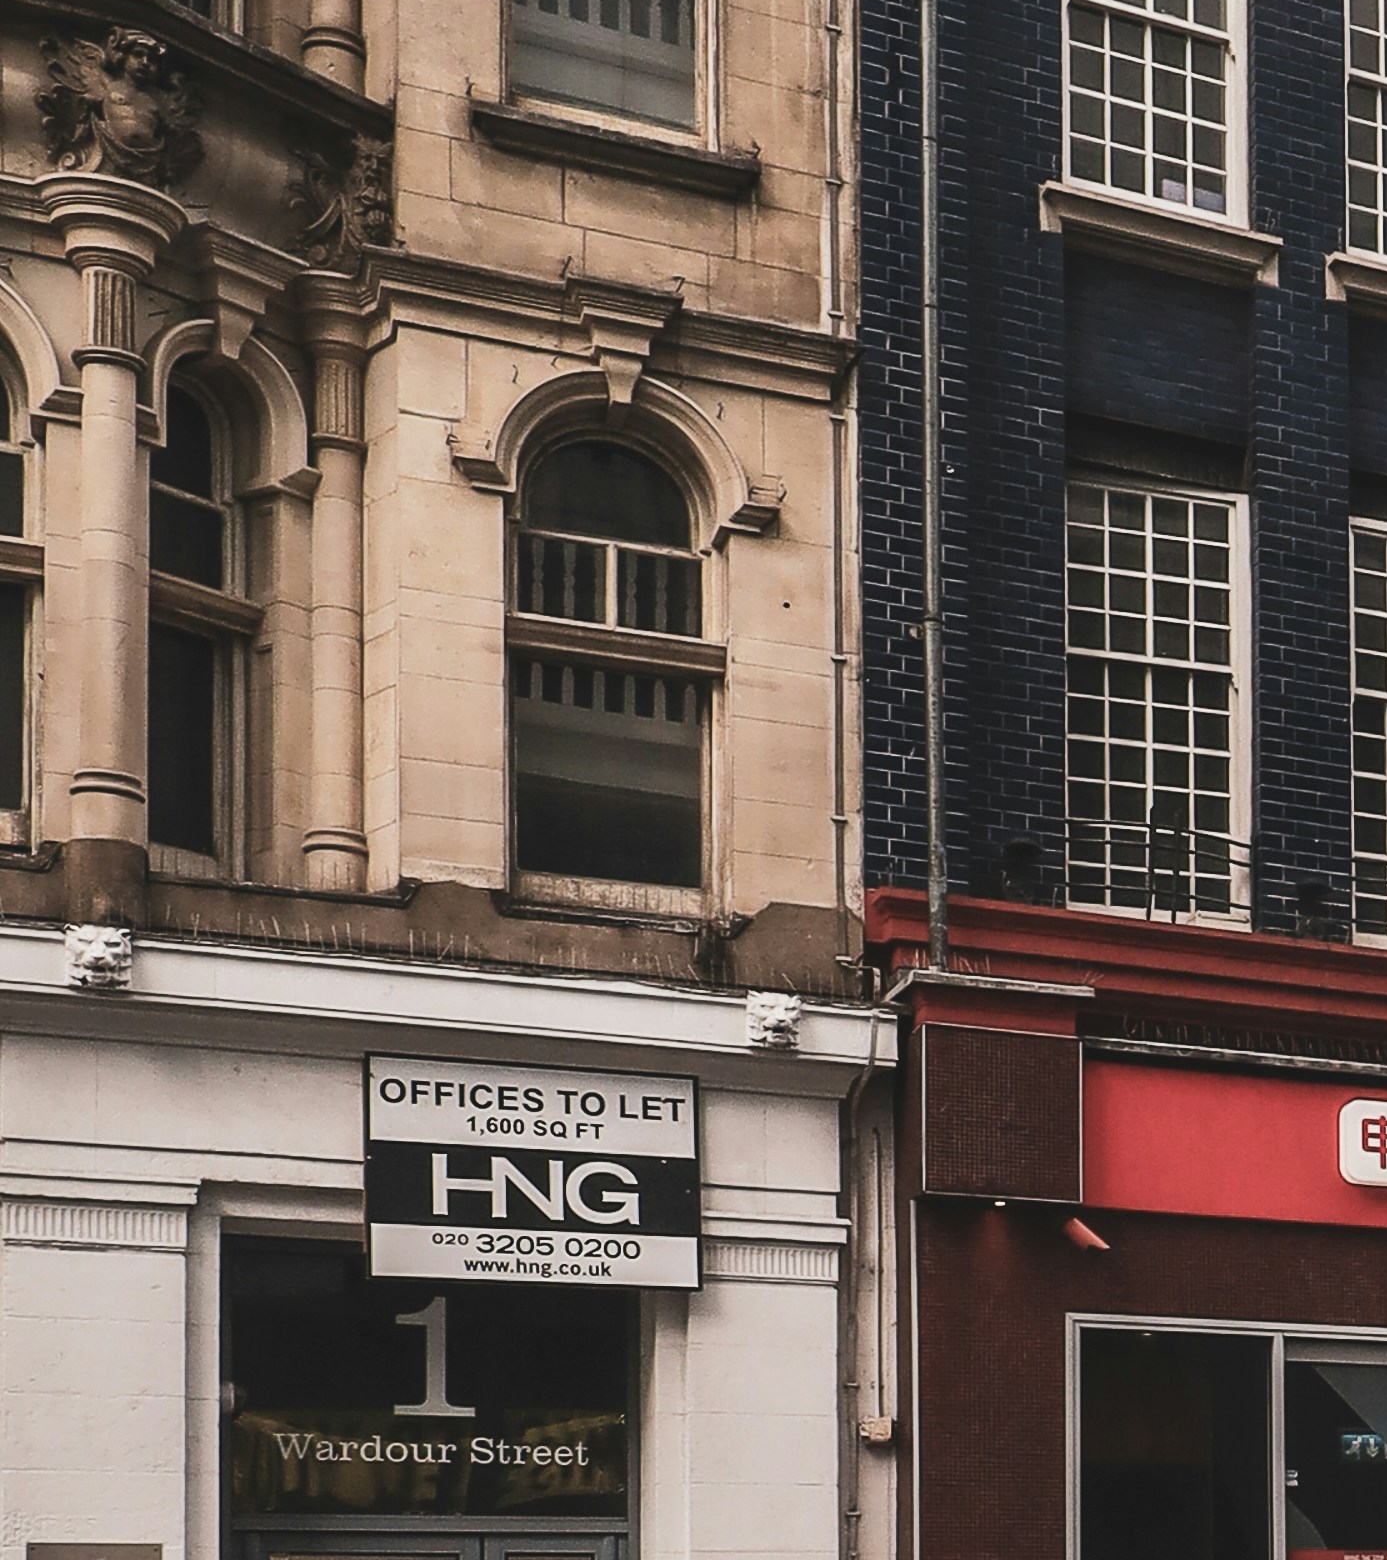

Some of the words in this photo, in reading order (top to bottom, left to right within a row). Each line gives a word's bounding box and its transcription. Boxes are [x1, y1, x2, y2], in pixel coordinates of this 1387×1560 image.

[379, 1078, 544, 1113] OFFICES
[557, 1090, 606, 1117] TO
[619, 1094, 686, 1122] LET
[466, 1116, 526, 1136] 1,600
[533, 1120, 568, 1139] SQ
[575, 1122, 605, 1140] FT
[431, 1153, 641, 1227] HNG
[431, 1232, 469, 1247] 020
[475, 1233, 555, 1256] 3205
[564, 1239, 641, 1260] 0200
[463, 1258, 613, 1278] www.hng.co.uk
[394, 1296, 476, 1418] 1
[273, 1433, 457, 1464] Wardour
[469, 1436, 590, 1467] Street
